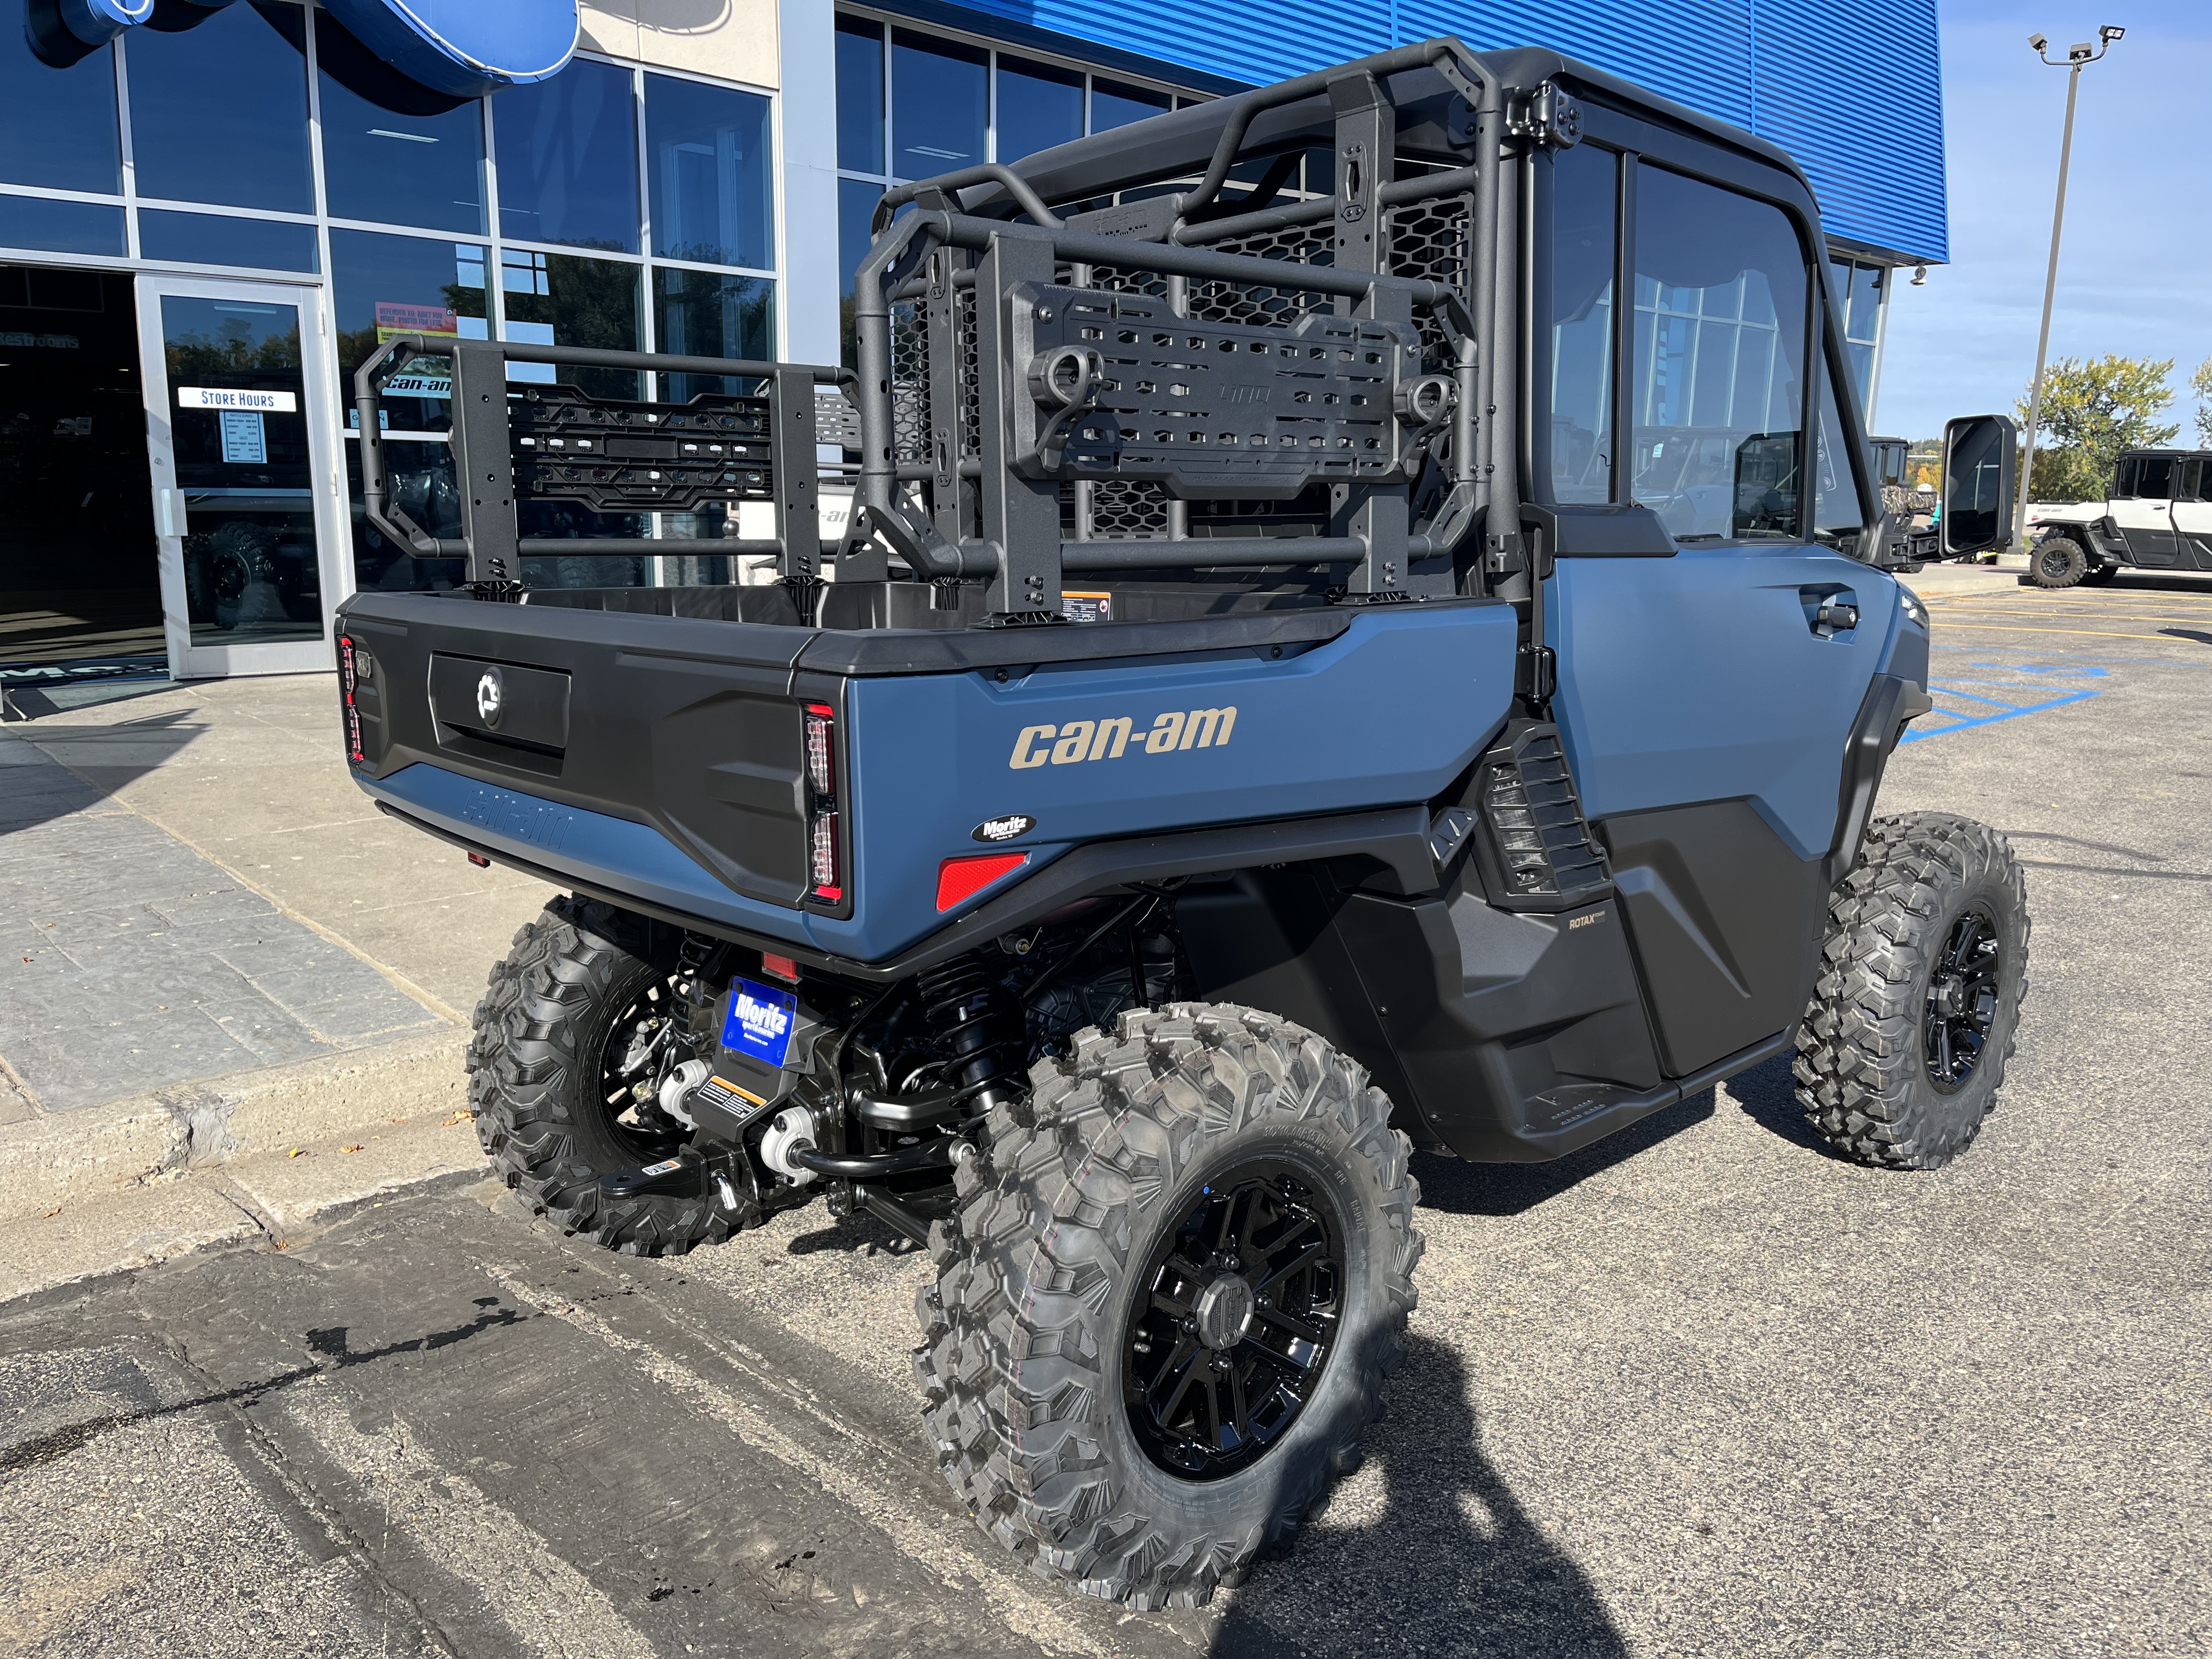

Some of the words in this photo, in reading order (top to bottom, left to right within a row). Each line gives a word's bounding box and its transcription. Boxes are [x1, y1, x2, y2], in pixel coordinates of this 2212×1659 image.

[201, 391, 236, 405] STORE
[239, 392, 274, 407] HOURS
[1009, 706, 1238, 770] can-am
[983, 816, 1027, 836] Moritz
[1570, 913, 1595, 930] ROTAX
[735, 993, 788, 1035] Moritz
